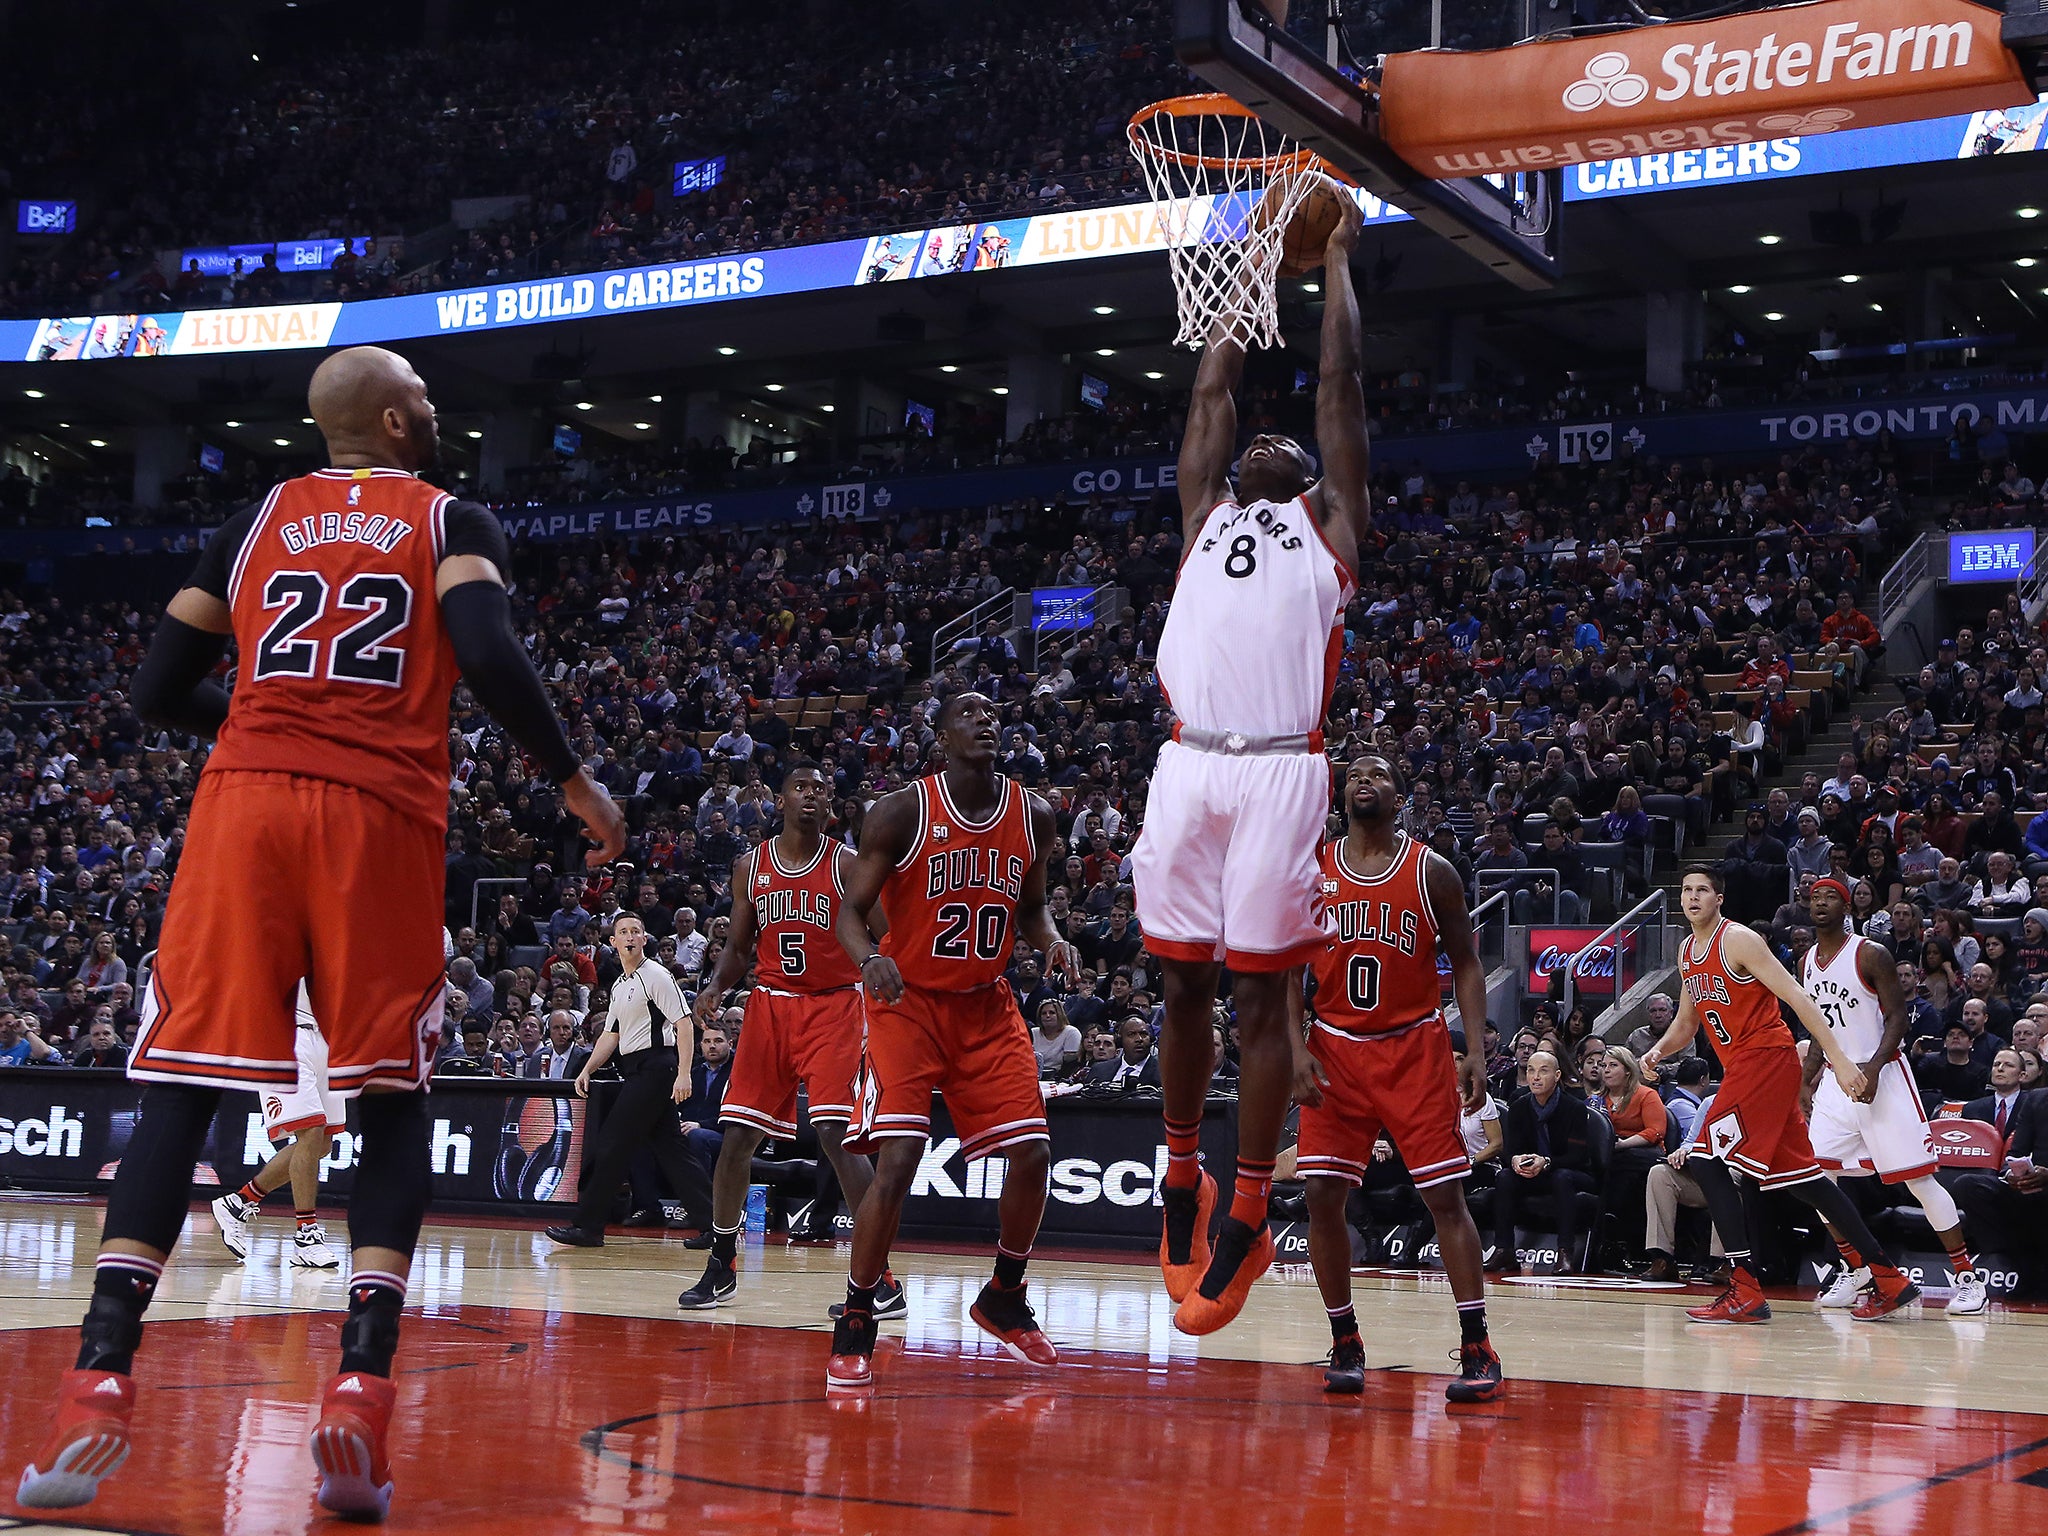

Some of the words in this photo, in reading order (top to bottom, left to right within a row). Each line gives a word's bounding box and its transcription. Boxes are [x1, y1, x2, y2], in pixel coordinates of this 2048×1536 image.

[683, 163, 717, 189] Bell
[1577, 136, 1801, 194] CAREERS
[27, 205, 67, 228] Bell
[294, 246, 323, 265] Bell
[436, 291, 488, 330] WE
[496, 280, 595, 322] BUILD
[604, 257, 765, 309] CAREERS
[191, 311, 319, 348] LiUNA!
[1760, 402, 1981, 442] TORONTO
[1564, 430, 1610, 457] 119
[1073, 468, 1122, 493] GO
[615, 502, 713, 531] LEAFS
[826, 488, 860, 513] 118
[279, 511, 414, 555] GIBSON
[1224, 535, 1256, 578] 8
[1961, 543, 2020, 571] IBM
[1041, 598, 1085, 621] IBM
[253, 569, 414, 689] 22
[933, 825, 948, 838] 50
[758, 875, 770, 885] 50
[926, 847, 1024, 902] BULLS
[1322, 881, 1338, 893] 50
[755, 890, 830, 931] BULLS
[931, 903, 1010, 960] 20
[1326, 900, 1418, 958] ULLS
[779, 932, 806, 976] 5
[1347, 954, 1381, 1011] 0
[1705, 1009, 1732, 1045] 3
[1820, 1002, 1847, 1029] 31
